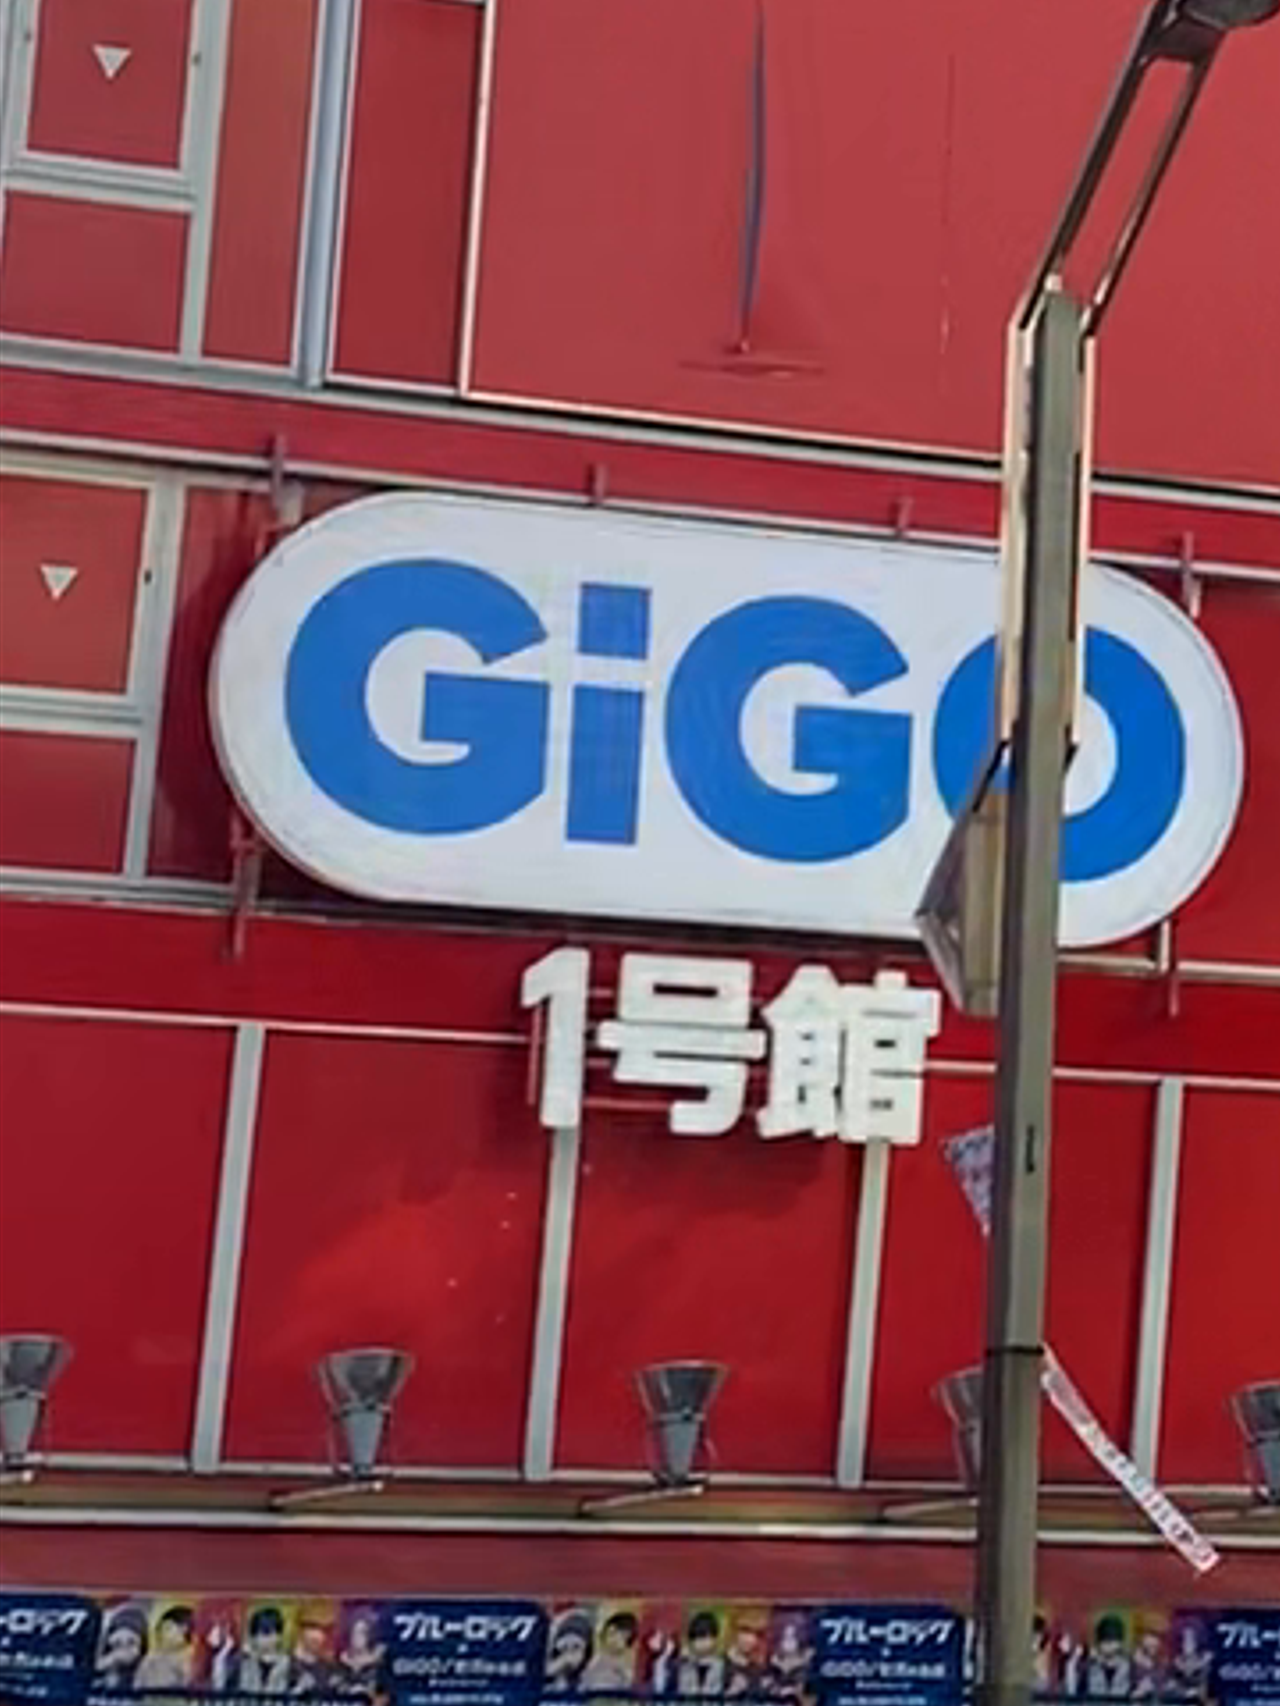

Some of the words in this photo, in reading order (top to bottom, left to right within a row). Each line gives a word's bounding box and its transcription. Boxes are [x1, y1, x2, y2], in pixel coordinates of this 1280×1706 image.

[285, 557, 1186, 884] GiGO
[521, 945, 942, 1144] 1号館
[393, 1613, 539, 1641] ブルーロック
[819, 1617, 956, 1647] ブルーロック
